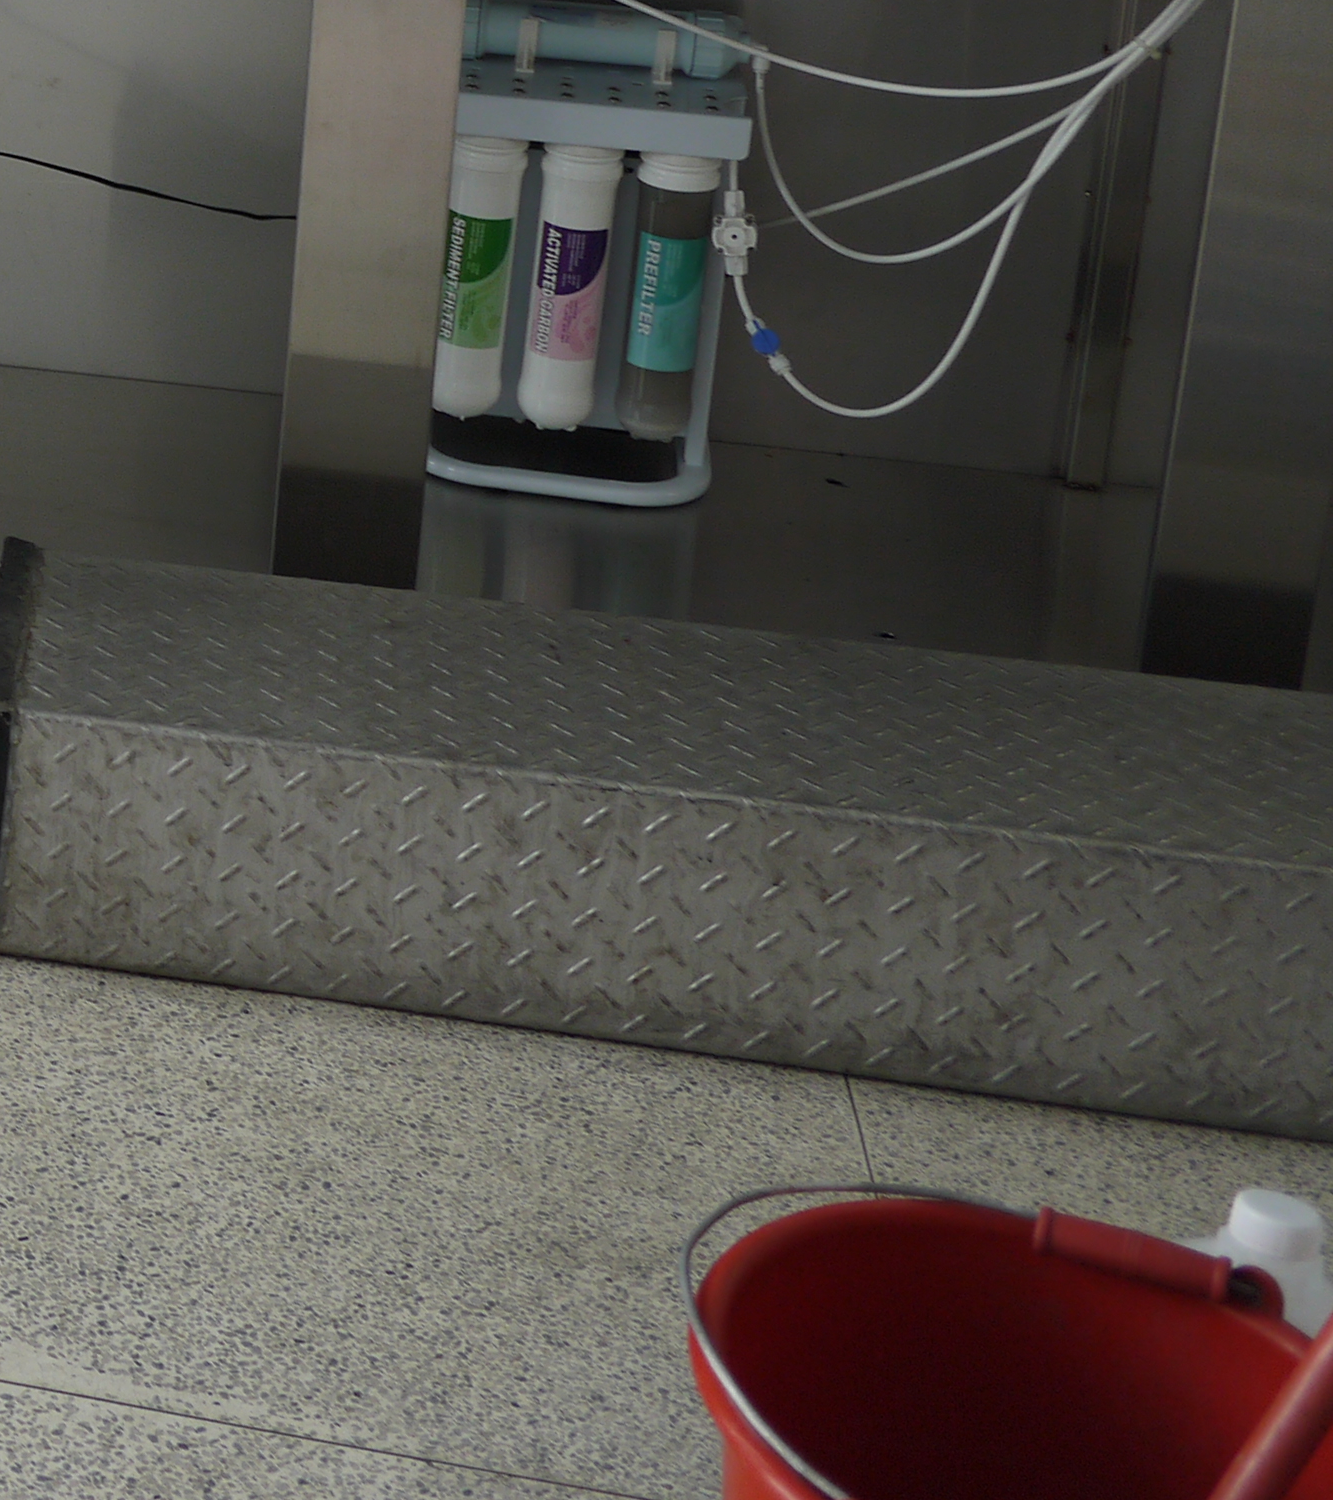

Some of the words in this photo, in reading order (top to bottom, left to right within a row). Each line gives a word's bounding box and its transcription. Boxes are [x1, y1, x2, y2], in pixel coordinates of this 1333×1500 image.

[445, 216, 466, 291] SEDIMENT
[540, 228, 563, 297] ACTIVATED
[637, 239, 661, 335] PREFILTER
[439, 290, 457, 339] FILTER
[534, 297, 554, 353] CARBON
